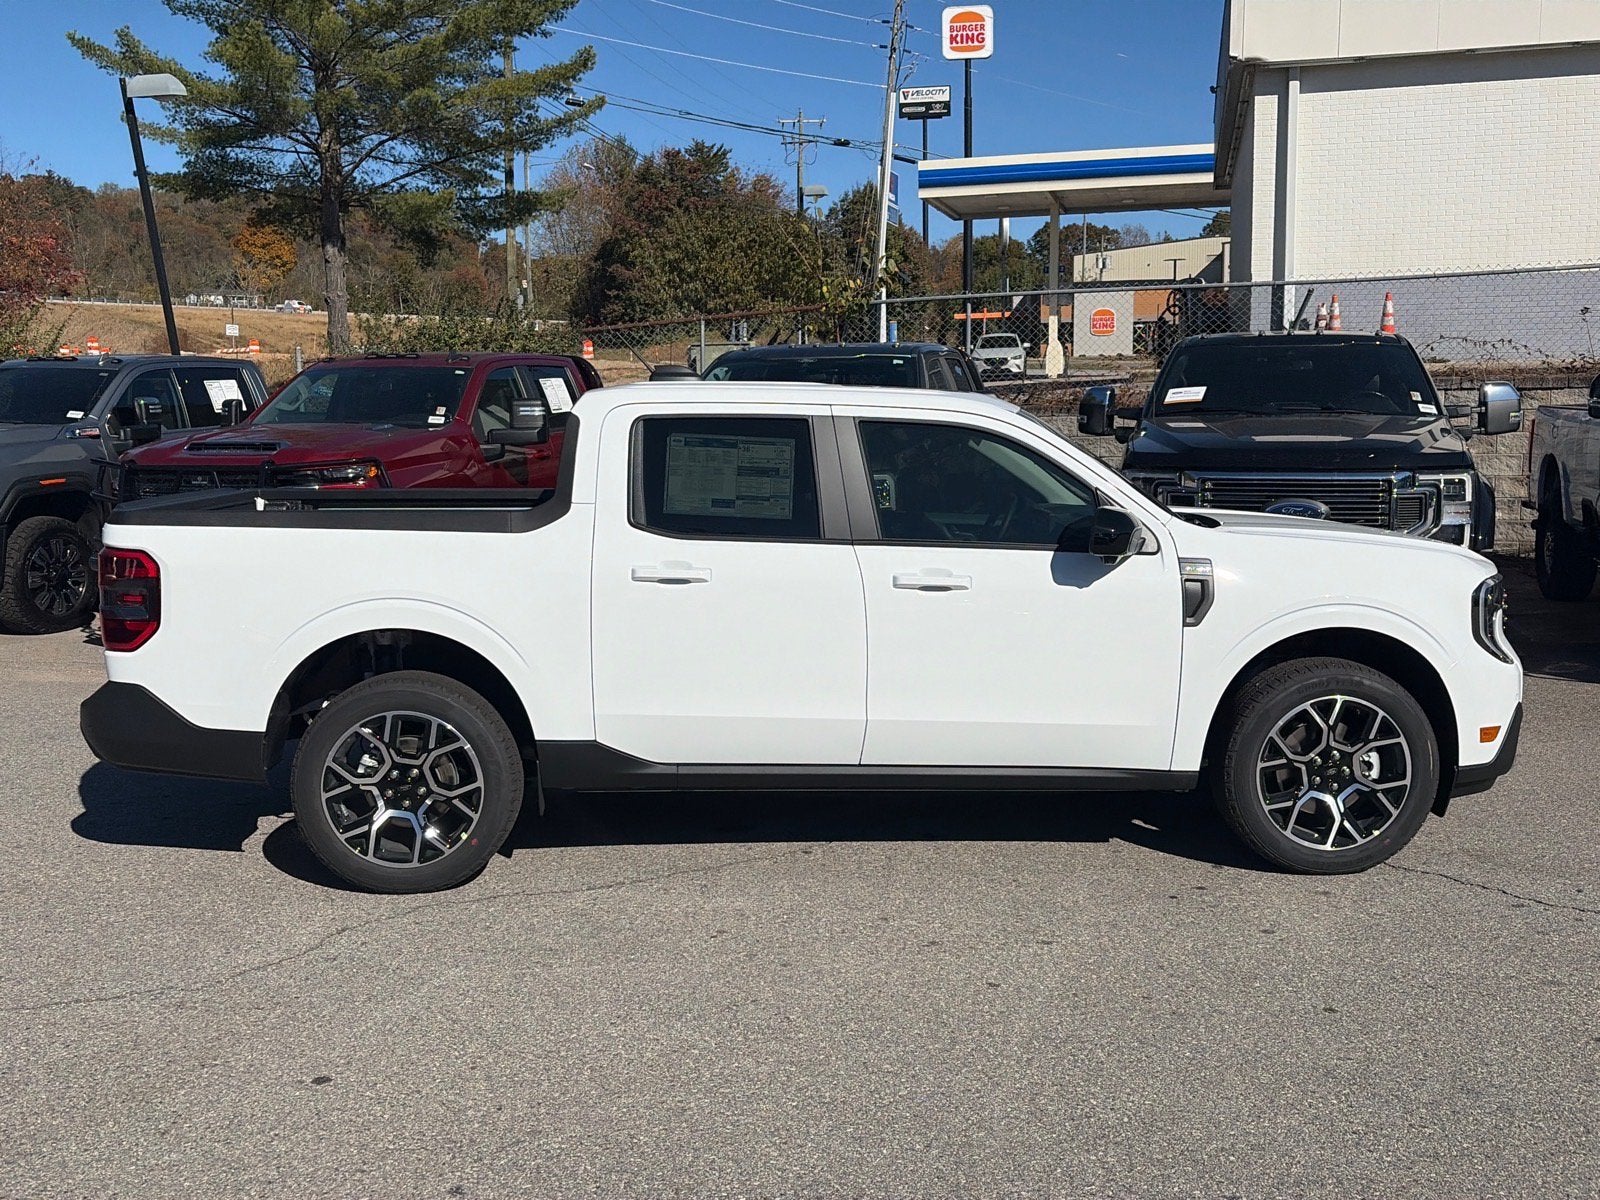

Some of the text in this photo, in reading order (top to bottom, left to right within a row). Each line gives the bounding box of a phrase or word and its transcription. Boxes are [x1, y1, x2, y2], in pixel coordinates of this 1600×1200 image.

[950, 24, 986, 32] BURGER
[950, 32, 986, 44] KING
[910, 88, 948, 96] VELOCITY
